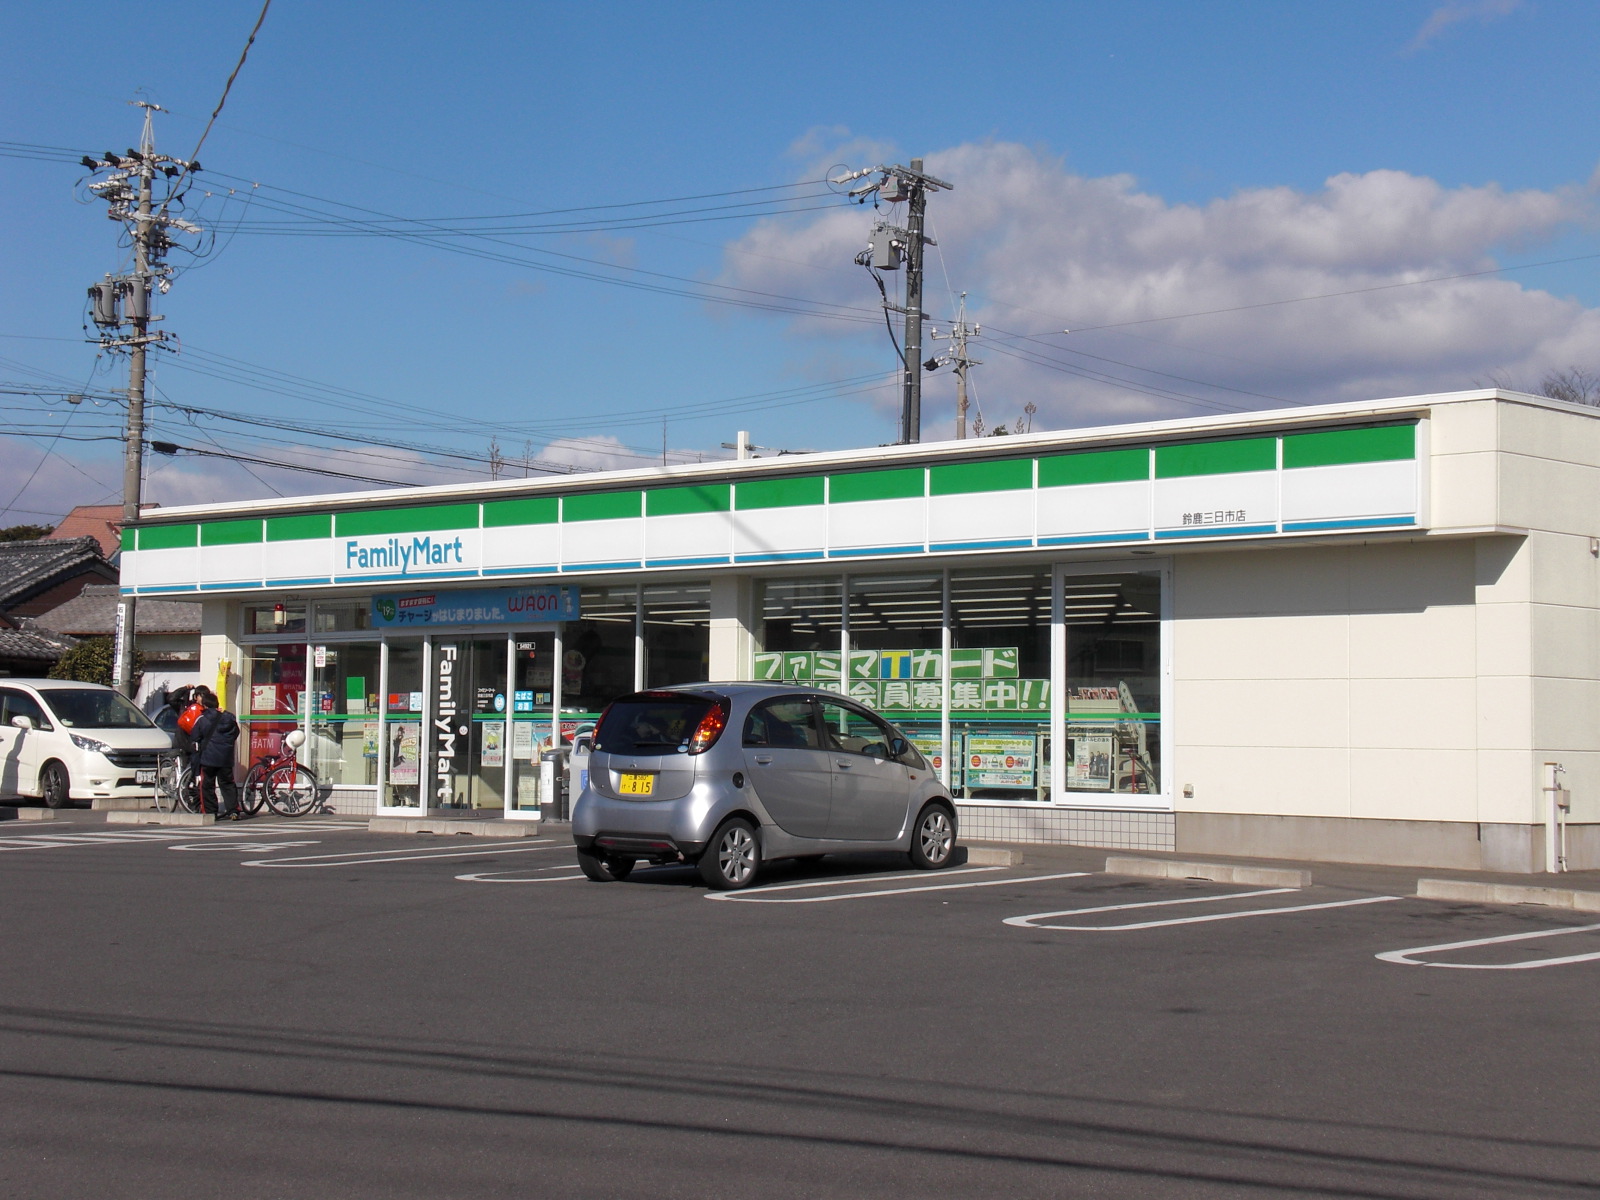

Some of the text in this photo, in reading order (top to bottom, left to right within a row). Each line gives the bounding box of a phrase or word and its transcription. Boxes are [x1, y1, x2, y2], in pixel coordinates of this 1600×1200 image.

[1182, 509, 1247, 525] 鈴鹿三日市店
[346, 536, 463, 574] FamilyMart
[508, 594, 558, 612] WAON
[754, 650, 1016, 679] ファミマTカード
[515, 691, 532, 700] たばこ
[434, 644, 457, 798] FamilyMart
